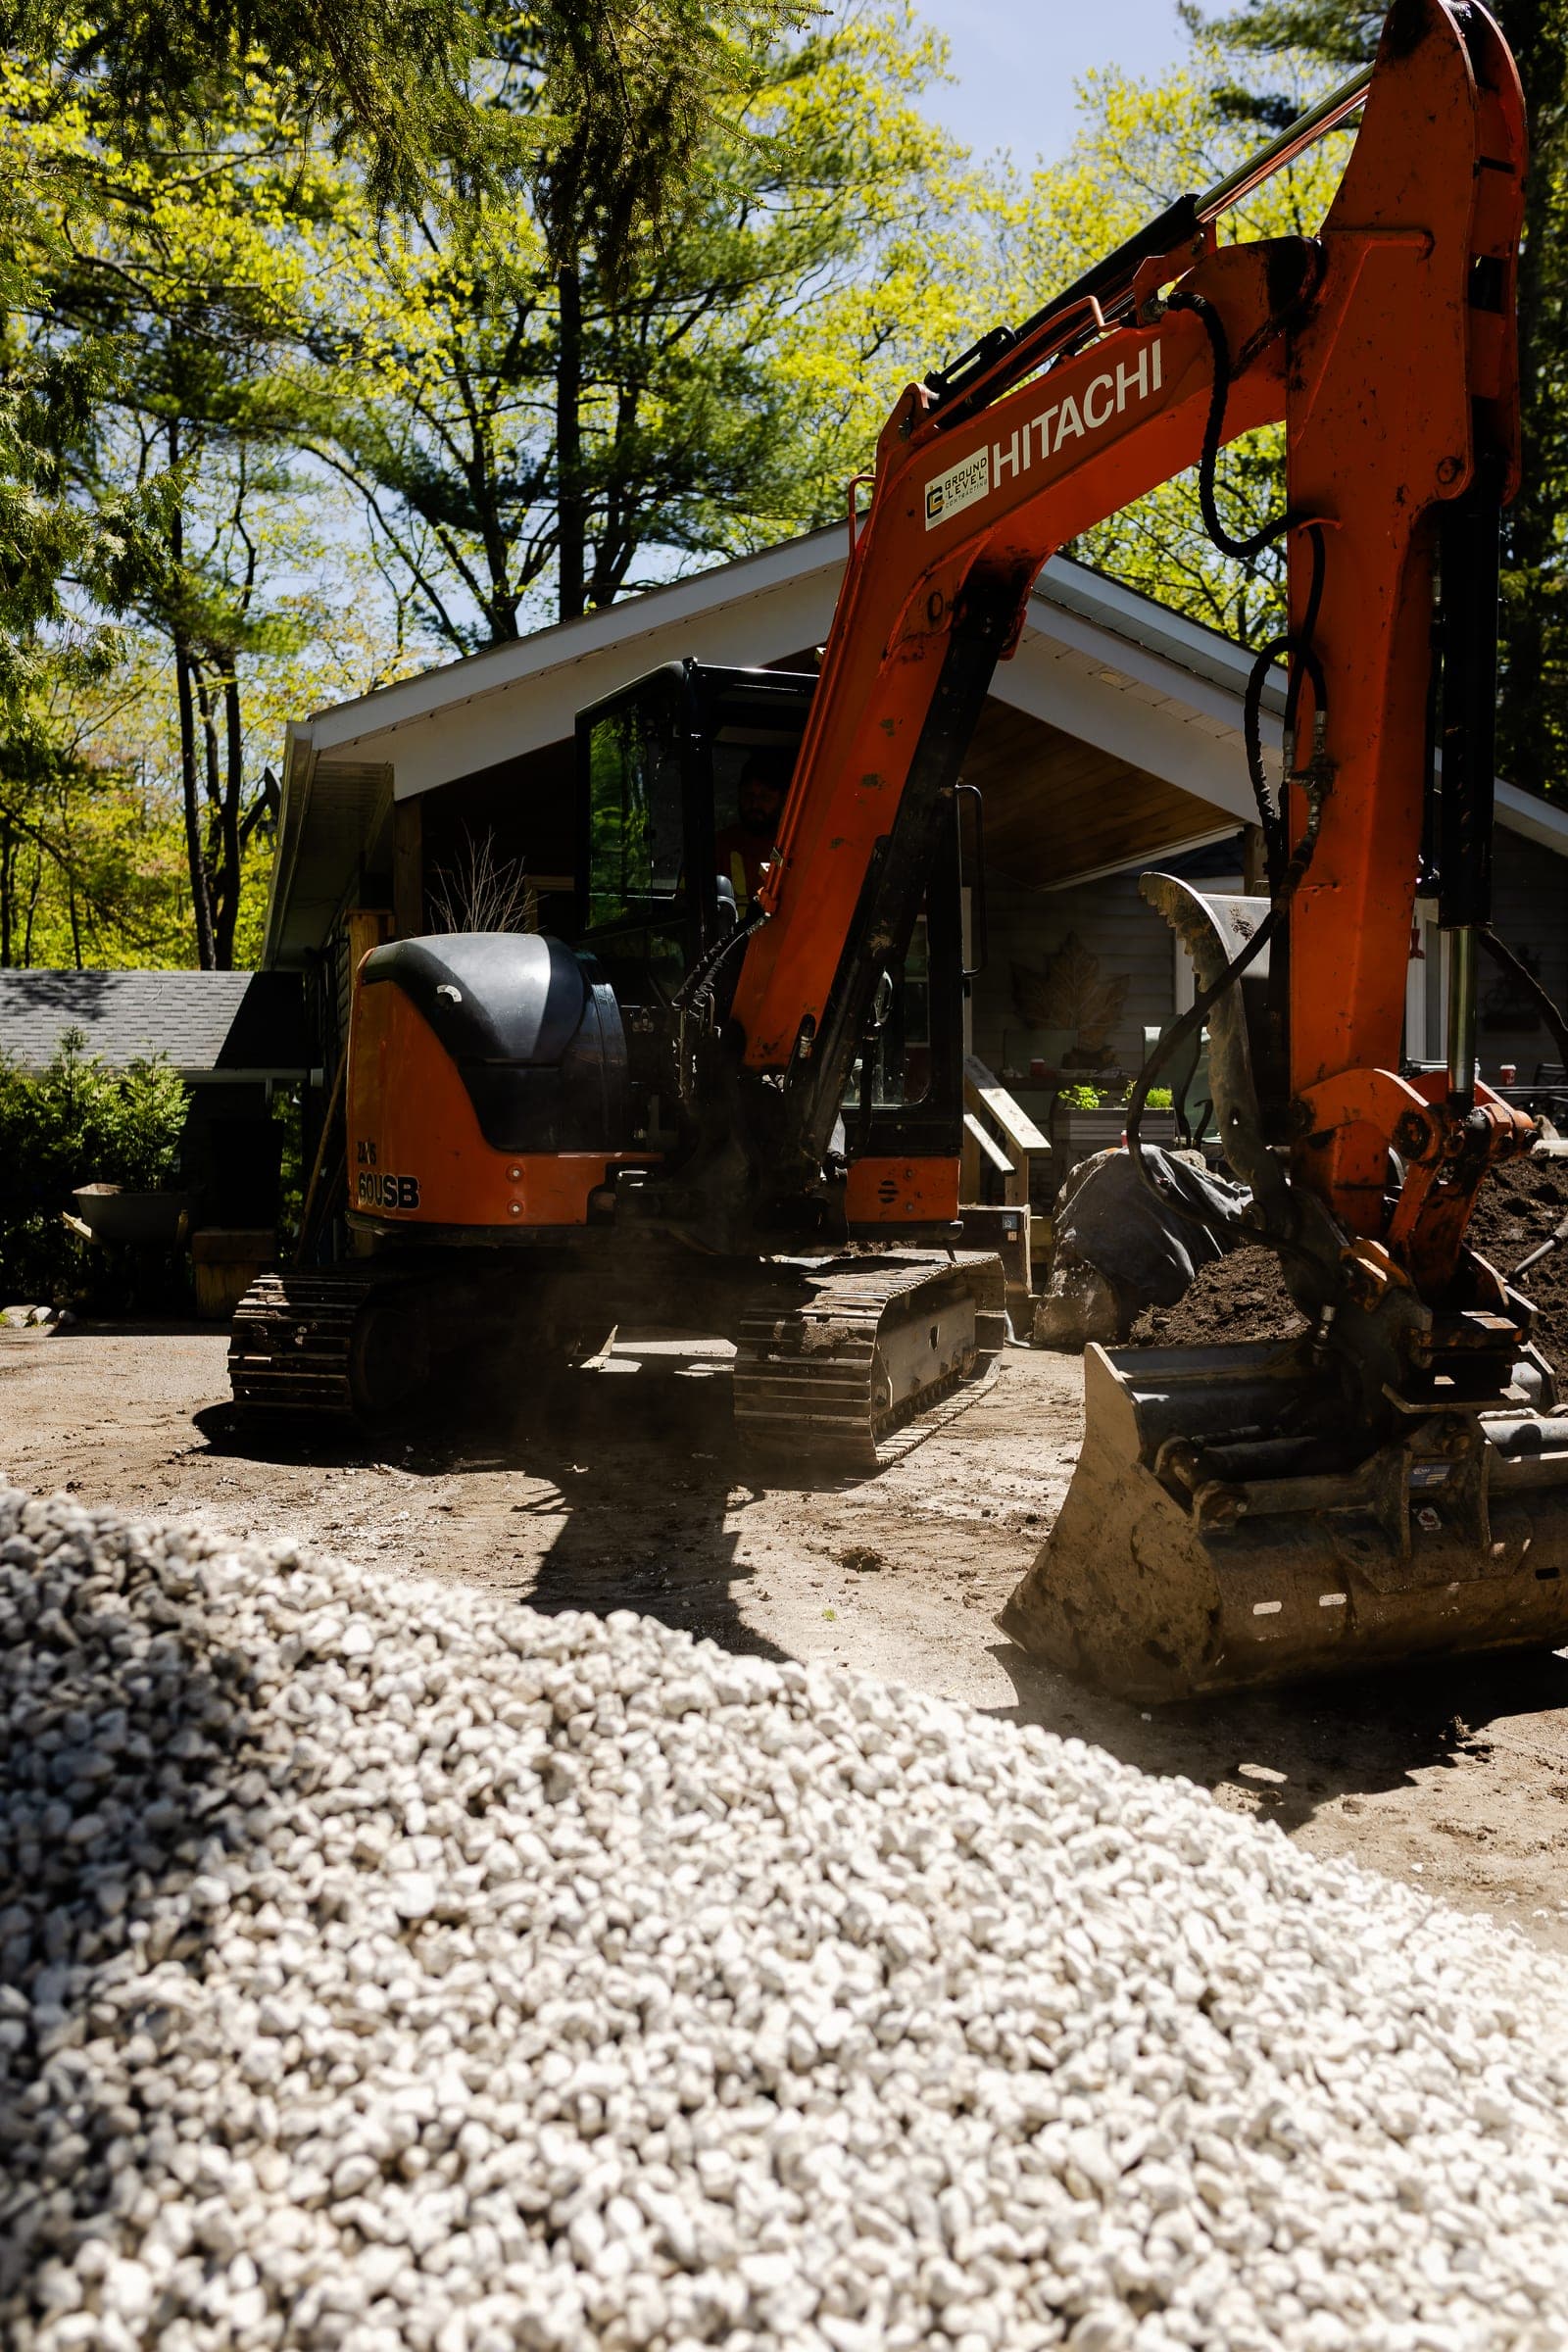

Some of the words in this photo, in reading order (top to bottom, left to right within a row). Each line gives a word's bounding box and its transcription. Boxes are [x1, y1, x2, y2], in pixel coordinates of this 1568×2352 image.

[993, 339, 1161, 488] HITACHI
[945, 457, 988, 491] GROUND
[948, 470, 984, 499] LEVEL
[359, 1171, 421, 1210] 60USB
